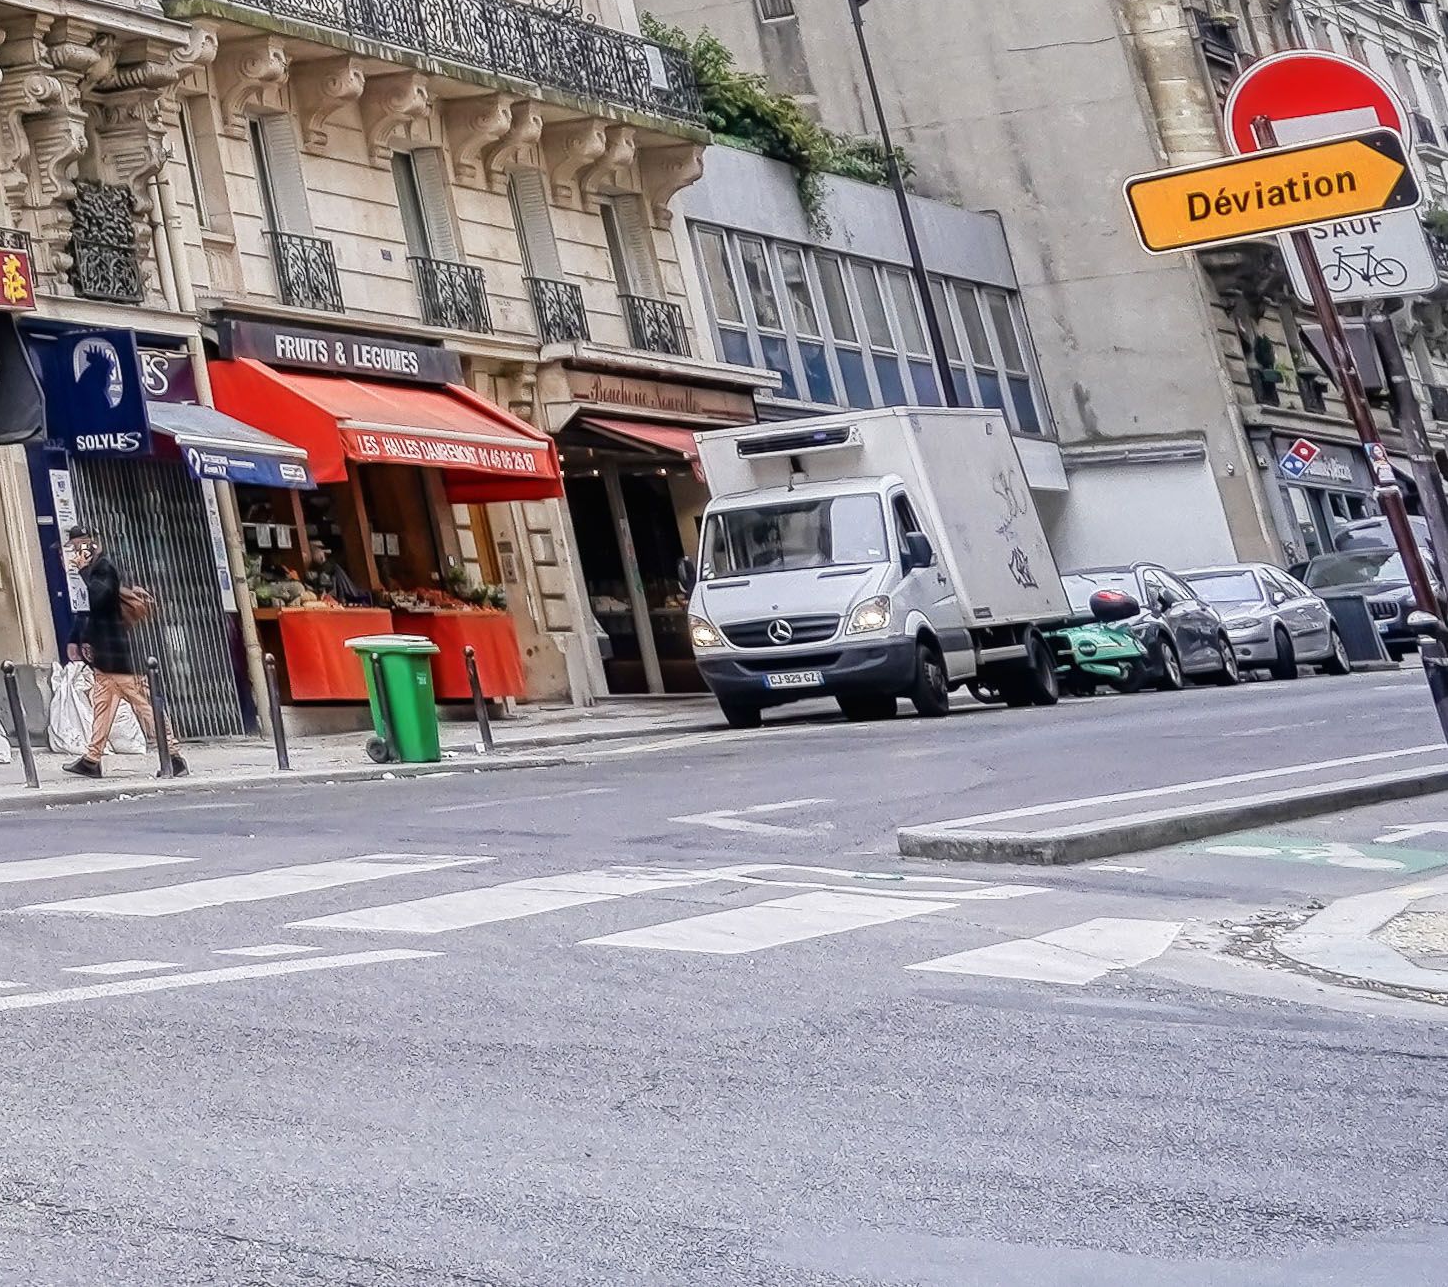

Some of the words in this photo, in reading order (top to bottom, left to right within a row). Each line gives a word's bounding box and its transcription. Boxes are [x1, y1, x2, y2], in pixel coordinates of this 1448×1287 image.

[1187, 169, 1357, 222] Déviation
[1314, 216, 1382, 241] SAUF
[275, 334, 328, 364] FRUITS
[335, 341, 347, 366] &
[353, 343, 419, 374] LEGUMES
[76, 432, 142, 452] SOLYLES
[357, 435, 380, 455] LES
[382, 436, 422, 459] HALLES
